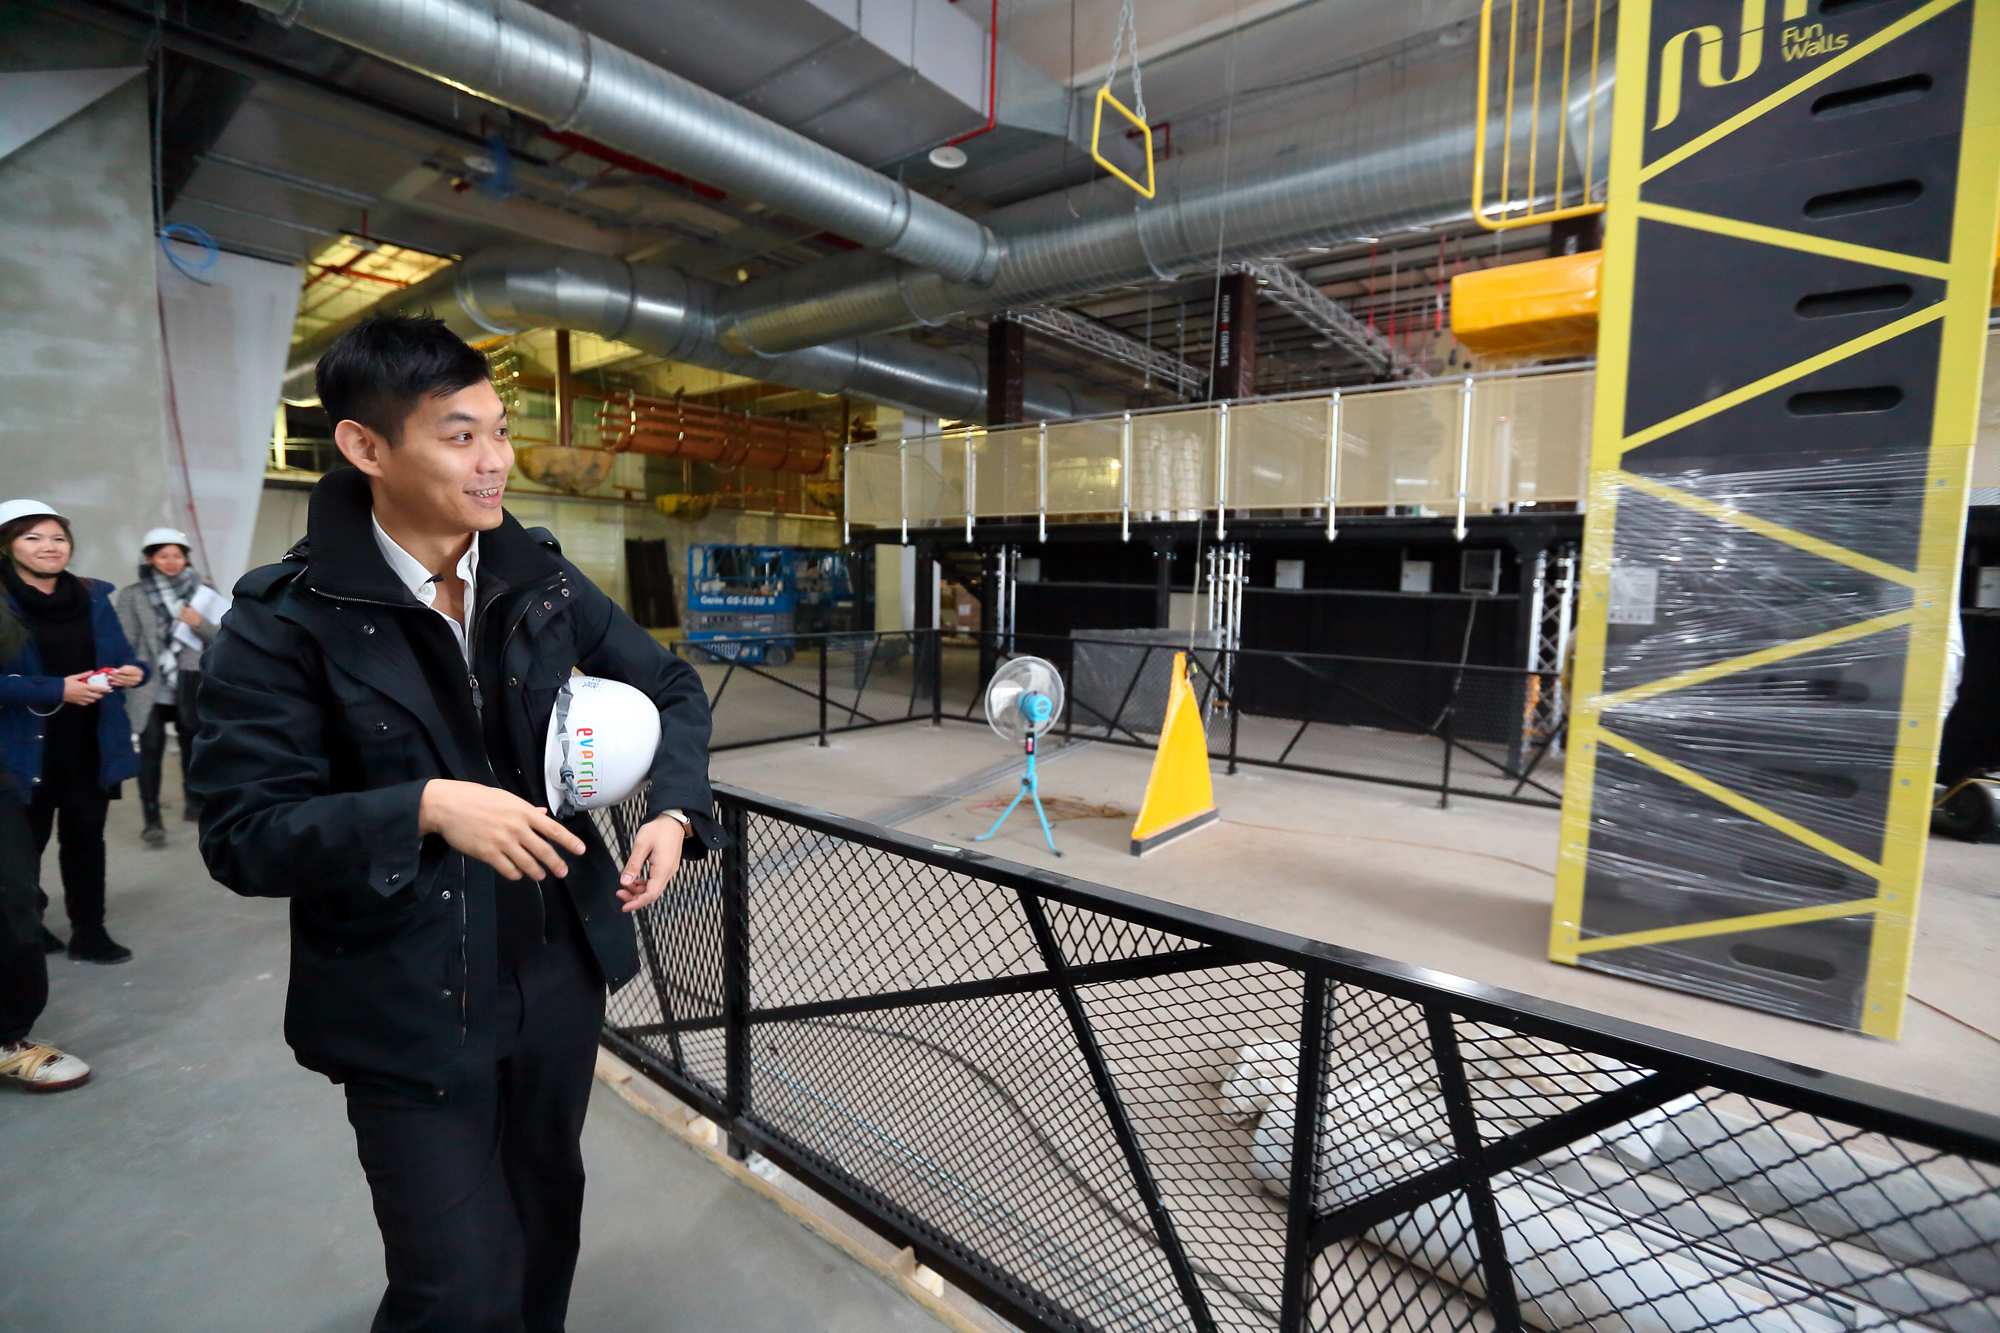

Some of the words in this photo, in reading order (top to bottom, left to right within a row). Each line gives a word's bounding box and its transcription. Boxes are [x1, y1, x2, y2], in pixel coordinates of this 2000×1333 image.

[1782, 23, 1823, 46] Fun
[1782, 33, 1849, 62] Walls
[1220, 330, 1229, 367] COURSE
